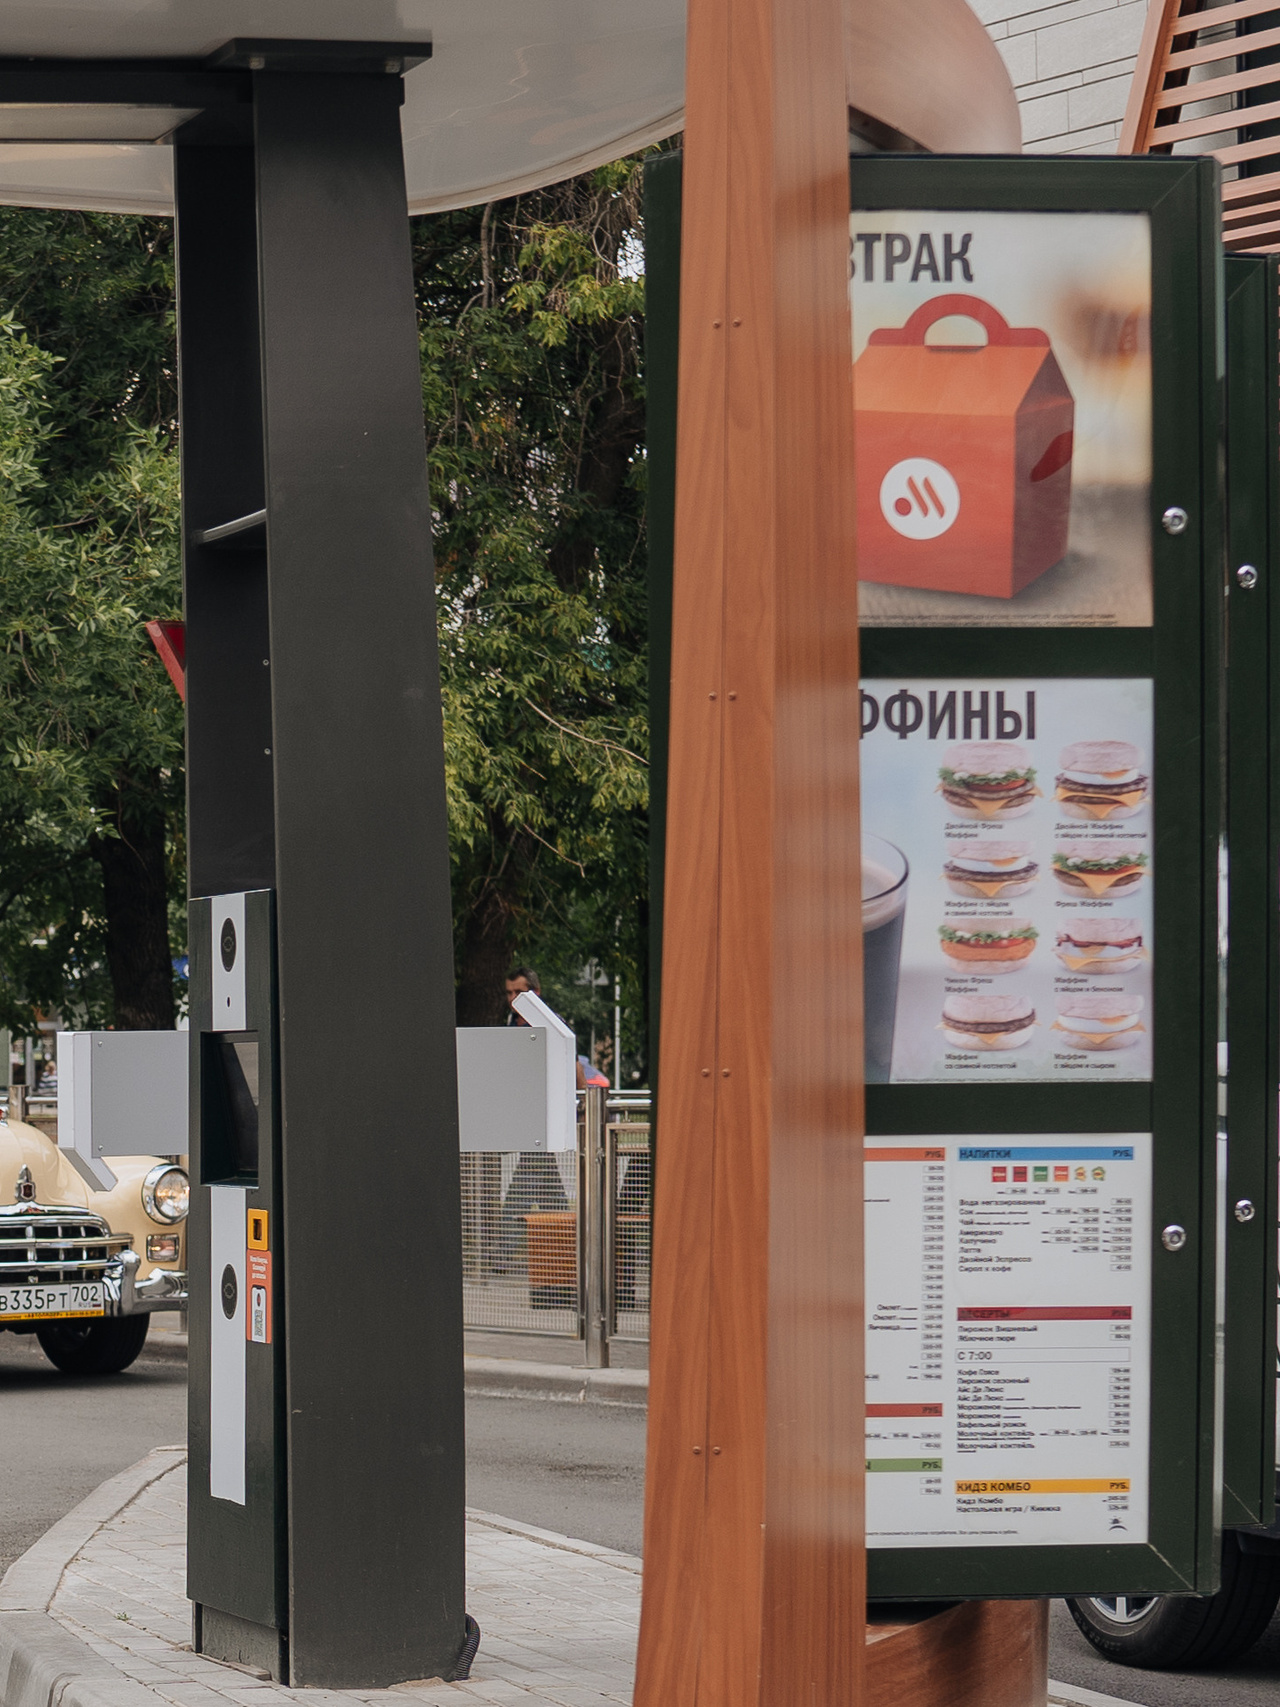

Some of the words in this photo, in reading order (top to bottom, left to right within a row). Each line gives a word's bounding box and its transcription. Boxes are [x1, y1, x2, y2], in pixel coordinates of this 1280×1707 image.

[1079, 900, 1113, 908] Маффин
[959, 1149, 1011, 1159] НАПИТКИ
[1112, 1149, 1132, 1157] РУБ.
[959, 1199, 979, 1207] Вода
[995, 1256, 1032, 1264] Эспрессо
[958, 1265, 983, 1273] Сироп
[991, 1265, 1011, 1273] кофе
[72, 1286, 99, 1302] 702
[957, 1325, 993, 1333] Пирожок
[995, 1325, 1038, 1333] Вишневый
[957, 1351, 966, 1360] С
[968, 1351, 993, 1360] 7:00
[957, 1421, 1001, 1429] Вафельный
[957, 1430, 998, 1438] Молочный
[957, 1442, 998, 1450] Молочный
[921, 1461, 942, 1469] РУБ.
[957, 1482, 987, 1493] КИДЗ
[990, 1481, 1031, 1492] КОМБО
[1109, 1482, 1129, 1490] РУБ.
[956, 1497, 976, 1506] Кидз
[978, 1497, 1004, 1505] Комбо
[956, 1505, 1002, 1513] Настольная
[1005, 1506, 1022, 1514] игра
